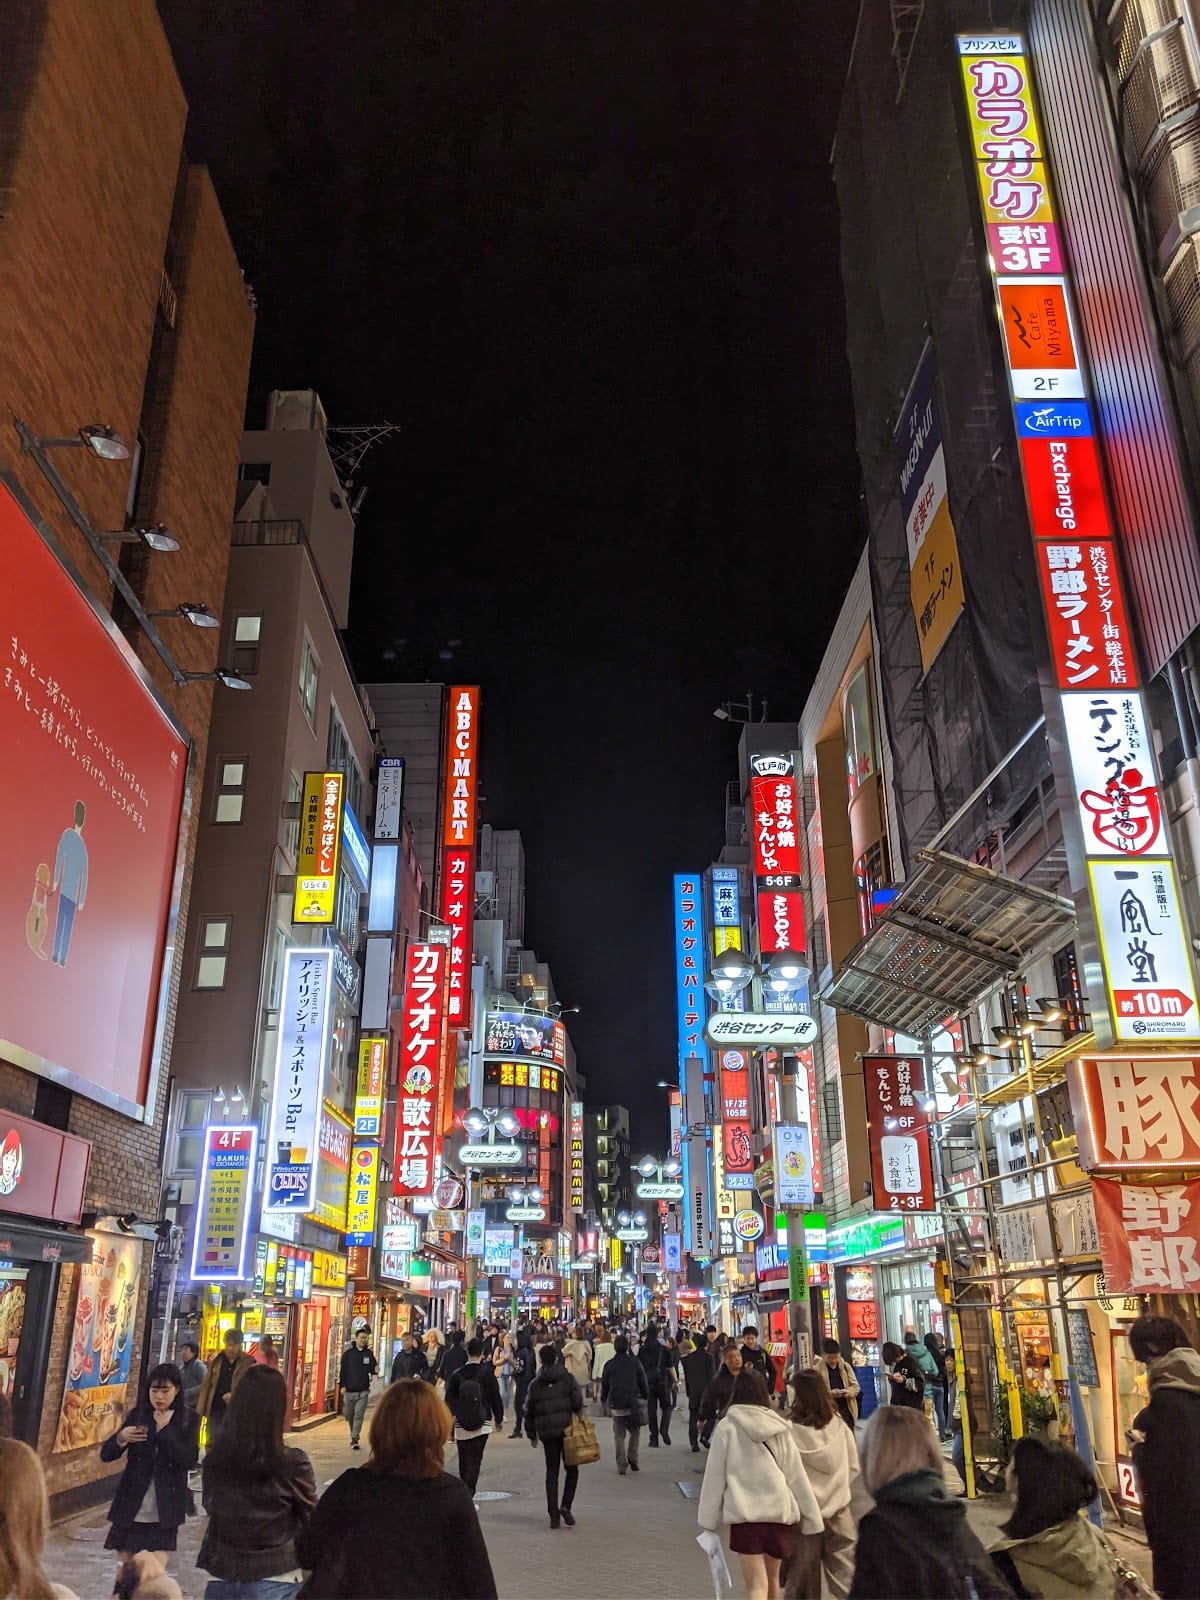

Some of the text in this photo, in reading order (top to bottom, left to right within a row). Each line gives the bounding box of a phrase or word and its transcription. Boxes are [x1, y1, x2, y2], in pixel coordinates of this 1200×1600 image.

[963, 40, 1017, 50] プリンスビル
[969, 60, 1042, 220] カラオケ
[998, 226, 1047, 245] 受付
[1002, 247, 1050, 270] 3F
[1027, 312, 1042, 341] Cafe
[1044, 298, 1062, 356] Miyama
[1033, 378, 1059, 391] 2F
[1035, 416, 1081, 429] AirTrip
[1049, 442, 1076, 530] Exchange
[1046, 545, 1100, 685] 野郎ラーメン
[1089, 546, 1127, 684] 渋谷センター街 総本店
[381, 759, 401, 767] CBR
[758, 761, 786, 771] 江戸前
[319, 780, 339, 873] 全身もみほぐし
[775, 783, 795, 847] お好み焼
[758, 811, 778, 870] もんじゃ
[720, 888, 732, 917] 麻雀
[1114, 870, 1162, 982] 一風堂
[1121, 993, 1182, 1014] 約10m
[713, 1022, 812, 1035] 渋谷センター街
[399, 946, 439, 1188] カラオケ 歌広場
[877, 1068, 893, 1112] もんじゃ
[896, 1061, 914, 1107] お好み焼
[285, 1103, 303, 1134] Bar
[359, 1119, 375, 1131] 2F
[219, 1132, 242, 1148] 4F
[271, 1172, 309, 1191] CELTS
[888, 1156, 901, 1190] お食事
[903, 1143, 916, 1188] ケーキと
[356, 1171, 371, 1204] 松屋
[740, 1222, 759, 1233] KING
[1120, 1185, 1200, 1290] 野郎
